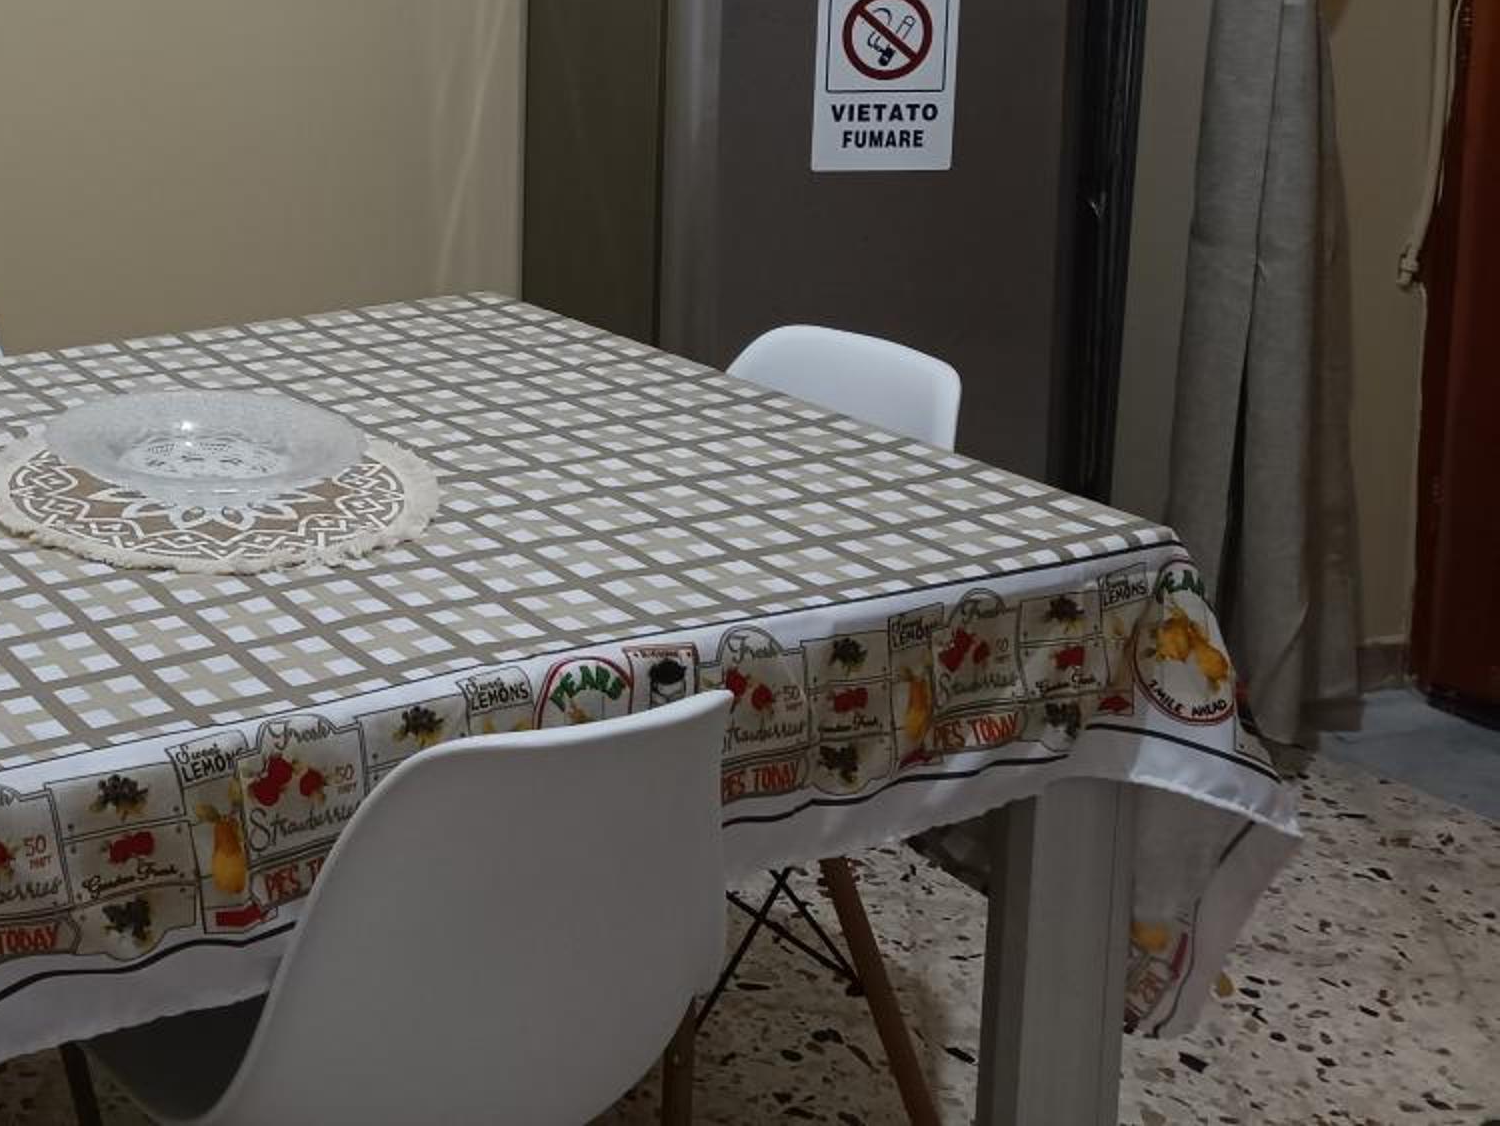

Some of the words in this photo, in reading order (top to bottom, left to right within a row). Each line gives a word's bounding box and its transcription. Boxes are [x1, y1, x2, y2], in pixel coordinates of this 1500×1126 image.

[831, 103, 939, 122] VIETATO
[842, 130, 924, 149] FUMARE
[471, 682, 530, 711] LEMONS
[23, 834, 47, 857] 50
